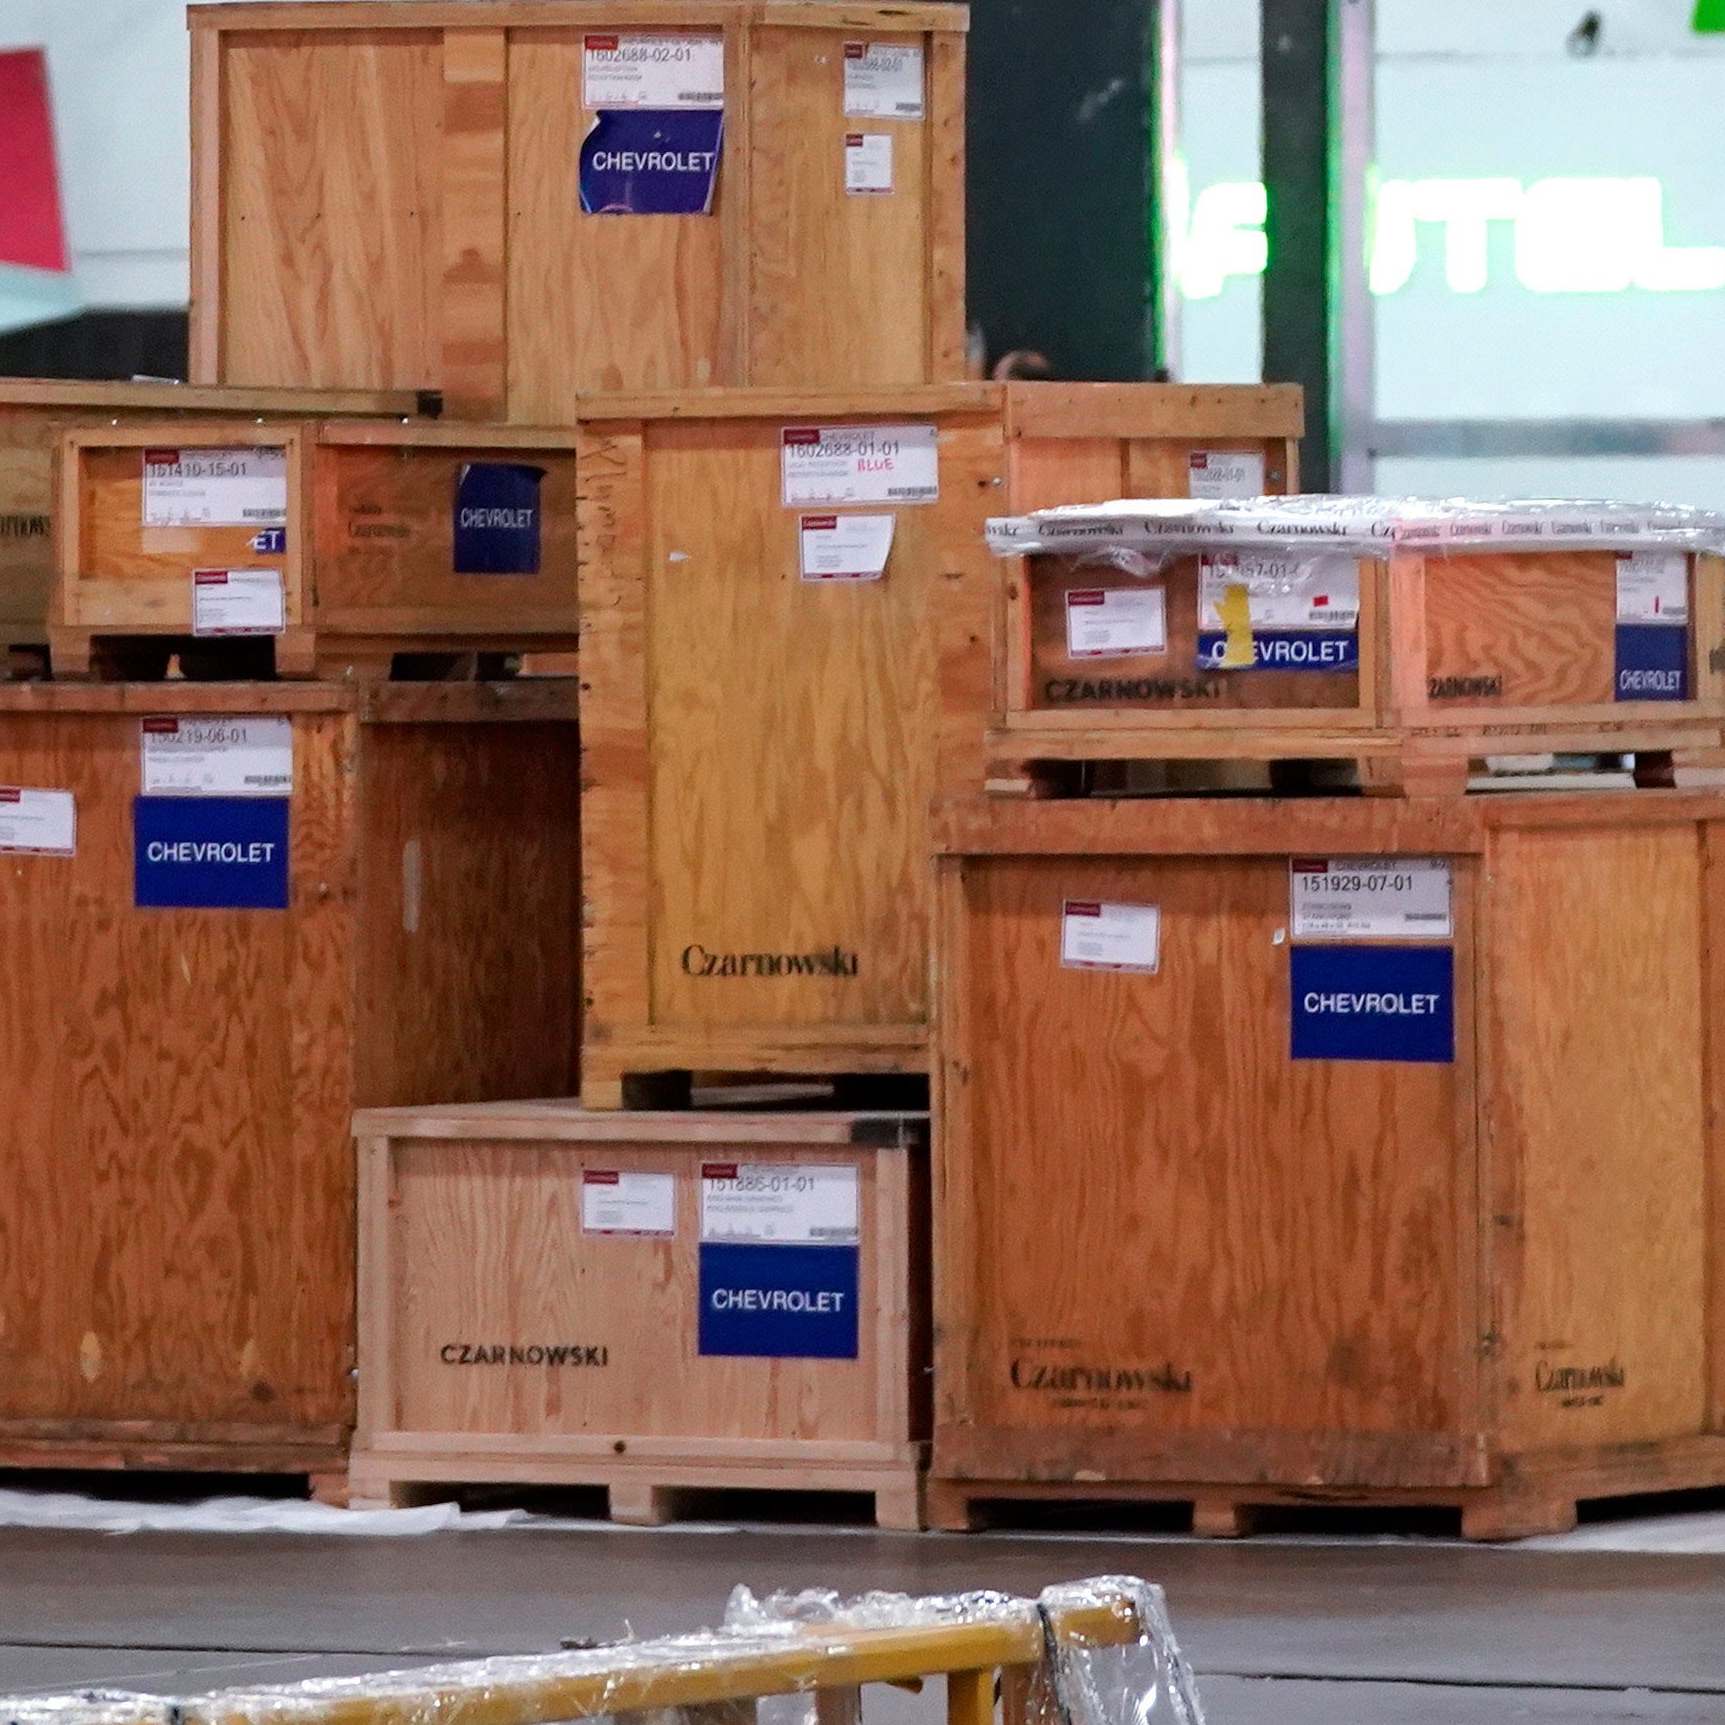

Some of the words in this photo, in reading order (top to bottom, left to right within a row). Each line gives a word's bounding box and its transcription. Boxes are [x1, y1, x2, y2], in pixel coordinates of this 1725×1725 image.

[592, 150, 715, 172] CHEVROLET
[857, 458, 895, 472] BLUE
[460, 506, 534, 529] CHEVROLET
[1211, 639, 1350, 663] CEVROLET
[1043, 678, 1222, 704] CZARNOWSKI
[1619, 669, 1682, 692] CHEVROLET
[146, 841, 275, 864] CHEVROLET
[1302, 875, 1414, 892] 151929-07-01
[681, 943, 860, 978] Czarnowski
[1303, 991, 1441, 1015] CHEVROLET
[711, 1287, 845, 1313] CHEVROLET
[440, 1343, 610, 1368] CZARNOWSKI
[1009, 1356, 1194, 1395] Czarnowski
